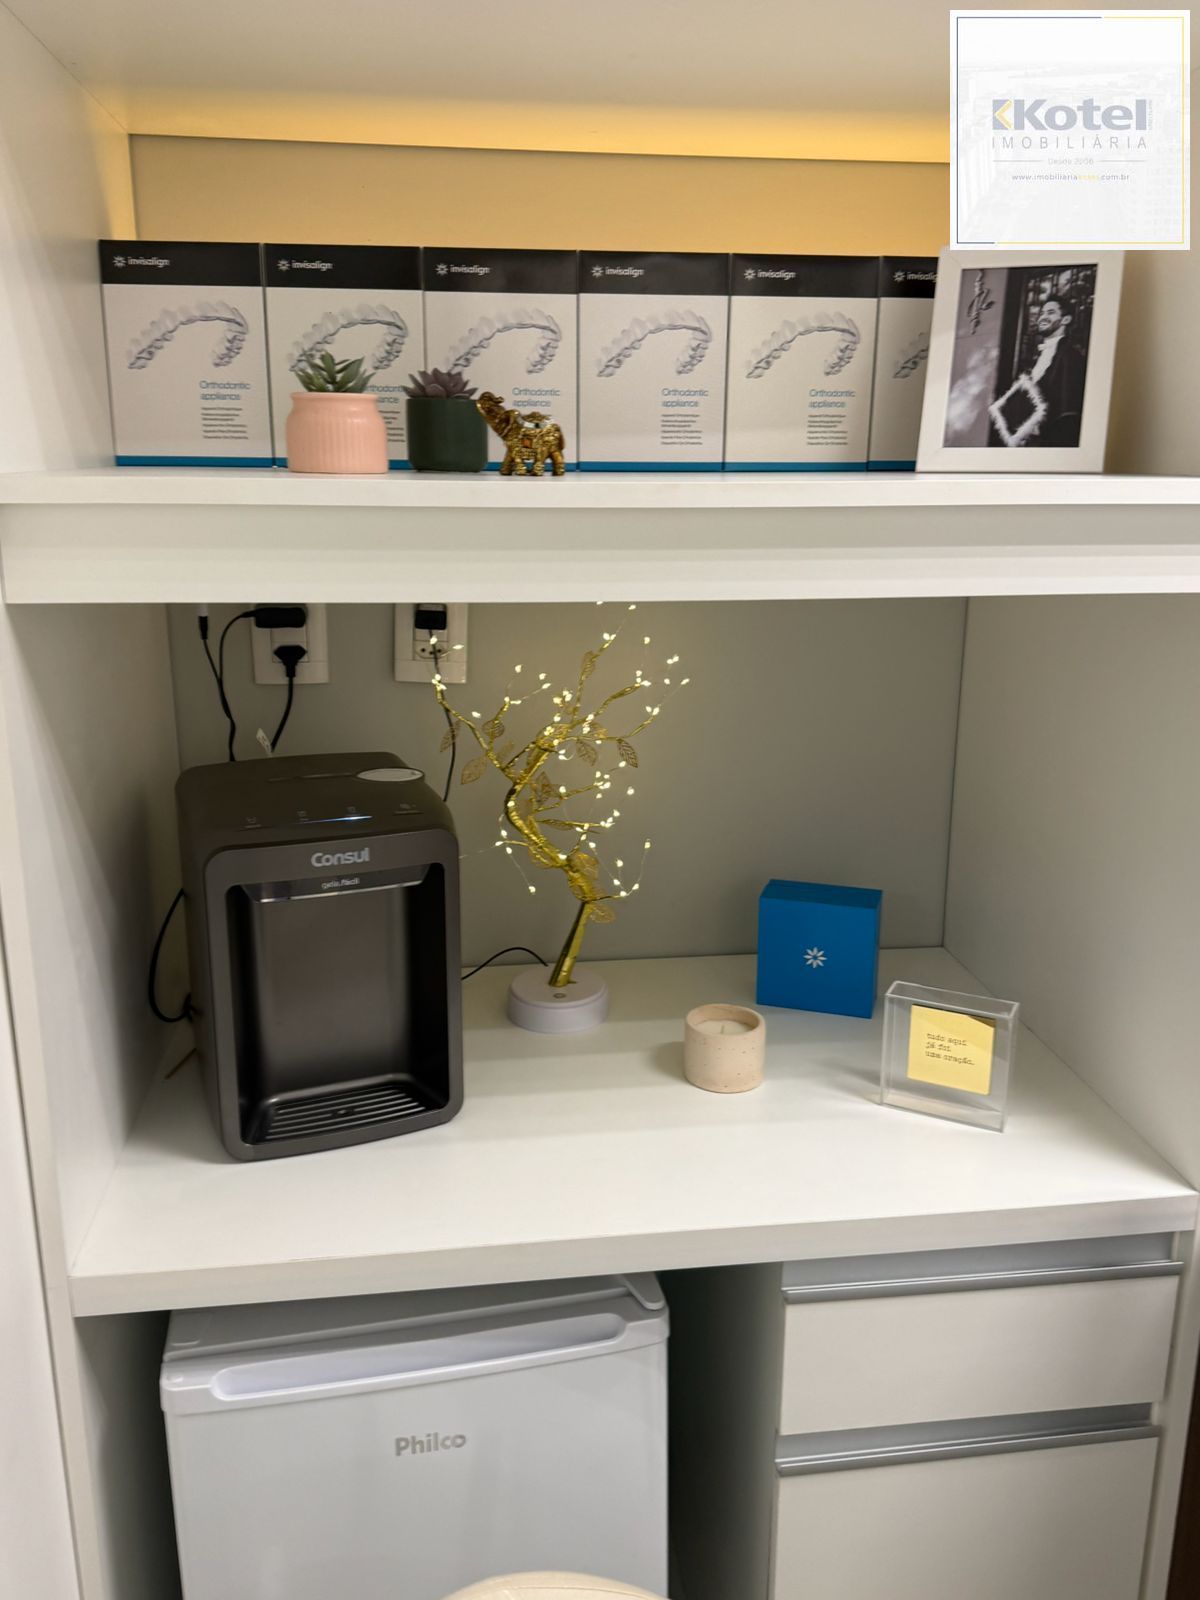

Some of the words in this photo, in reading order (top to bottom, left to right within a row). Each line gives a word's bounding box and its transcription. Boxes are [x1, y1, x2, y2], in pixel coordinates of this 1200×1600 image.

[127, 256, 170, 268] invisalign
[291, 260, 333, 271] invisalign
[449, 264, 490, 276] invisalign
[605, 266, 645, 278] invisalign
[757, 269, 796, 281] invisalign
[511, 387, 561, 397] Orthodontic
[662, 388, 709, 397] Orthodontic
[808, 389, 856, 398] Orthodontic
[310, 847, 370, 868] Consul
[395, 1431, 467, 1457] Philco
